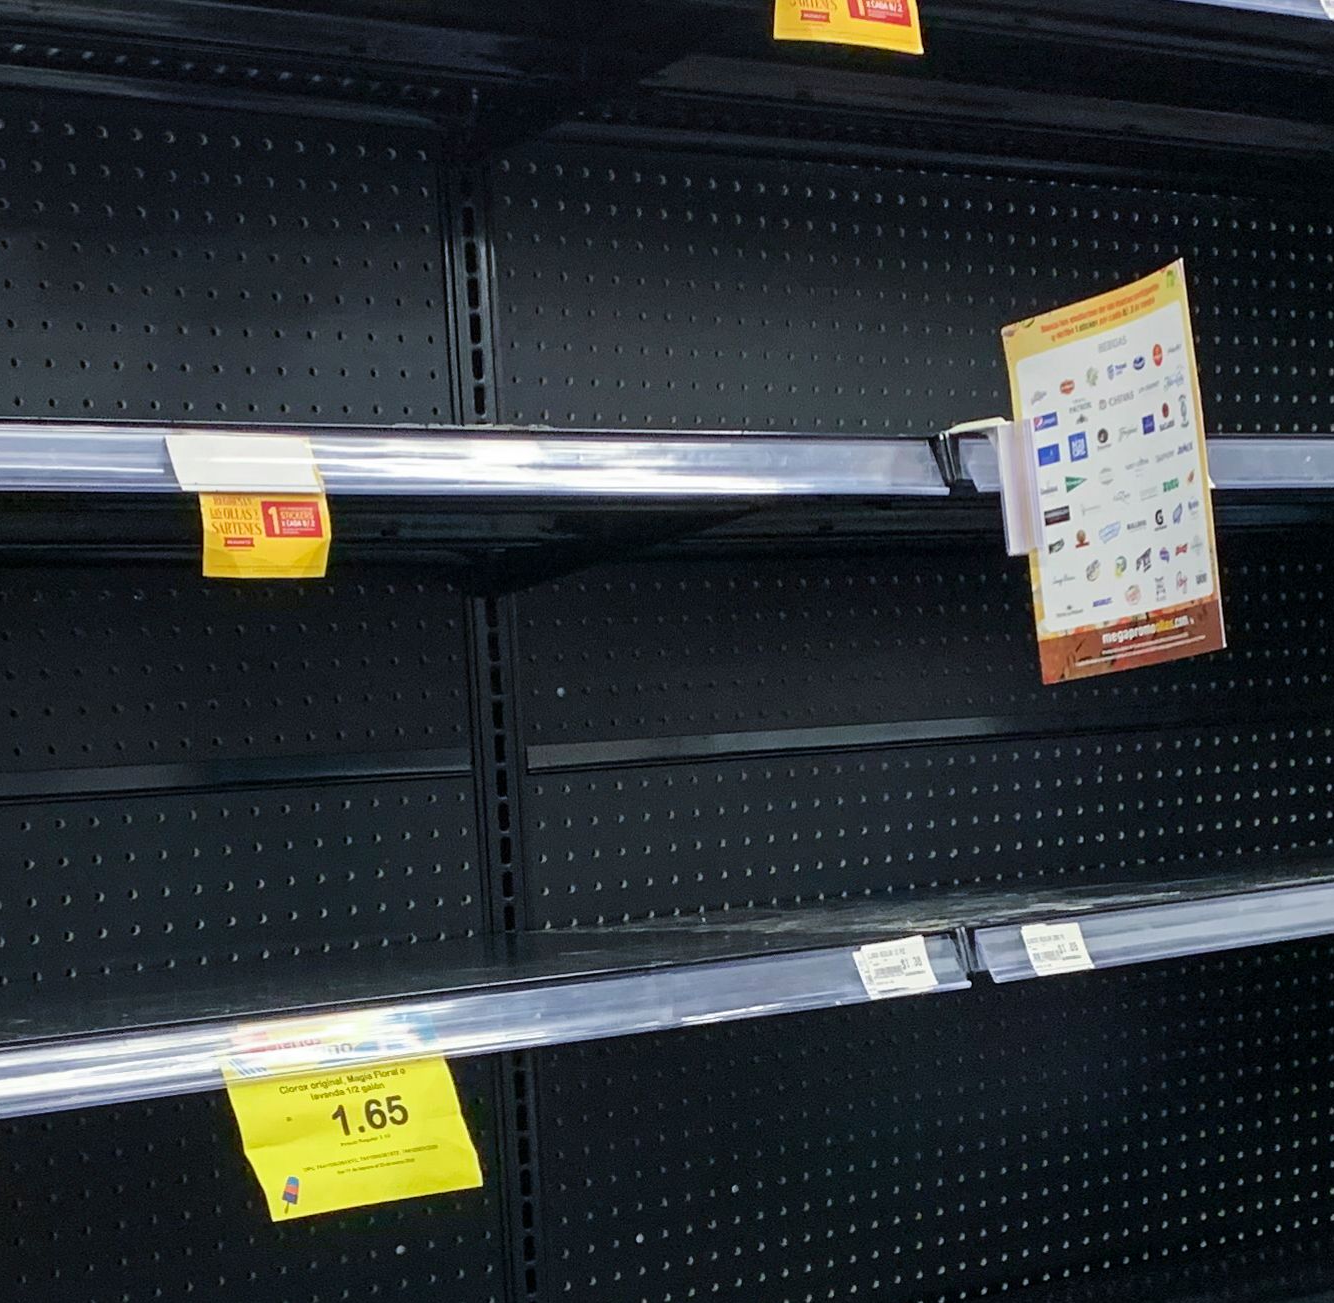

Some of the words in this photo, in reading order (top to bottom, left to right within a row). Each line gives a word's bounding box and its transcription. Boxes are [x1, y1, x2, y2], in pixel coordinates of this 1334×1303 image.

[211, 521, 262, 536] SARTENES
[268, 506, 280, 535] 1
[278, 1084, 309, 1095] Clorox
[373, 1068, 399, 1079] Floral
[331, 1094, 409, 1137] 1.65
